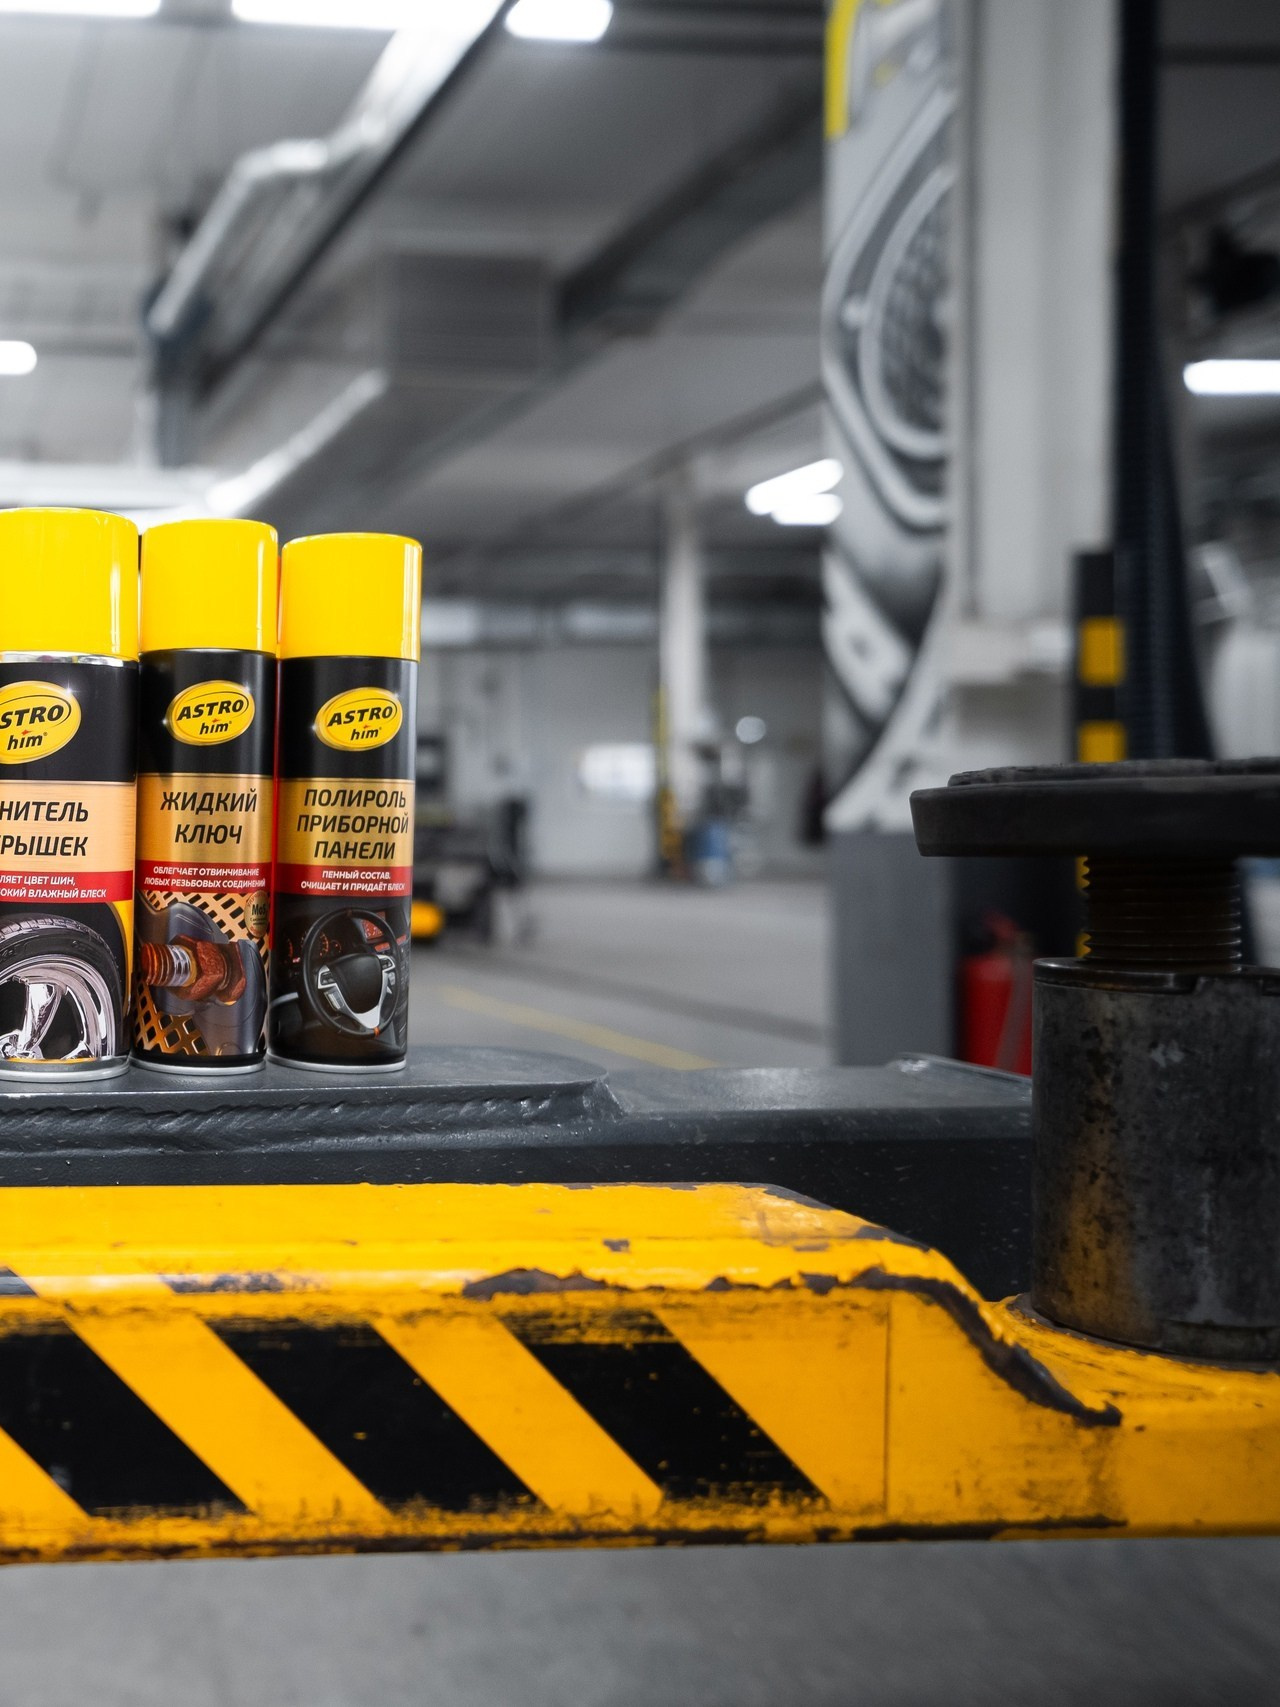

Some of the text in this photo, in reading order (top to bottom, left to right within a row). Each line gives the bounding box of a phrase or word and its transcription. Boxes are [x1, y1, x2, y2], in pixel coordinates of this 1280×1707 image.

[176, 699, 244, 722] ASTRO
[327, 706, 393, 727] ASTRO
[199, 722, 229, 735] him
[350, 728, 379, 741] him
[7, 734, 43, 751] him
[160, 788, 257, 815] ЖИДКИЙ
[304, 789, 406, 808] ПОЛИРОЛЬ
[297, 811, 408, 834] ПРИБОРНОЙ
[174, 823, 243, 844] КЛЮЧ
[314, 841, 396, 859] ПАНЕЛИ
[153, 866, 260, 876] ОБЛЕГЧАЕТ ОТВИНЧИВАНИЕ
[322, 870, 359, 879] ПЕННЫЙ
[23, 875, 50, 887] ЦВЕТ
[50, 876, 76, 887] ШИН,
[144, 877, 266, 888] ЛЮБЫХ РЕЗЬБОВЫХ СОЕДИНЕНИЙ
[300, 880, 342, 891] ОЧИЩАЕТ
[342, 881, 350, 891] И
[28, 887, 79, 898] ВЛАЖНЫЙ
[80, 888, 107, 898] БЛЕСК
